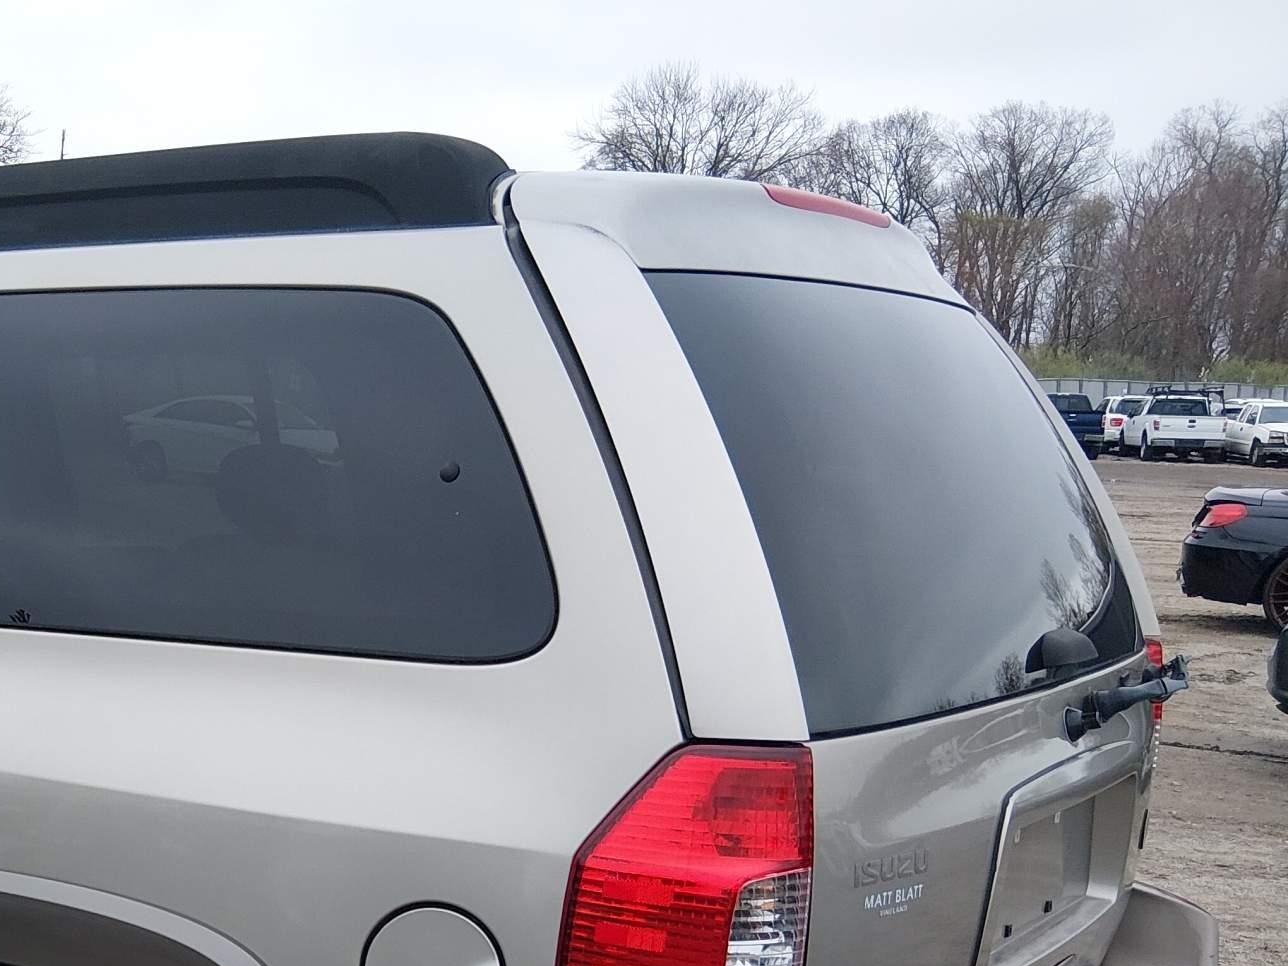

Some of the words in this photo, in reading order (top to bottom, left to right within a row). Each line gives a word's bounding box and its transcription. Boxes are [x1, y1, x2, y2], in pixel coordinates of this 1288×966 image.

[853, 847, 929, 888] ISUZU
[864, 890, 893, 910] MATT
[895, 884, 924, 904] BLATT
